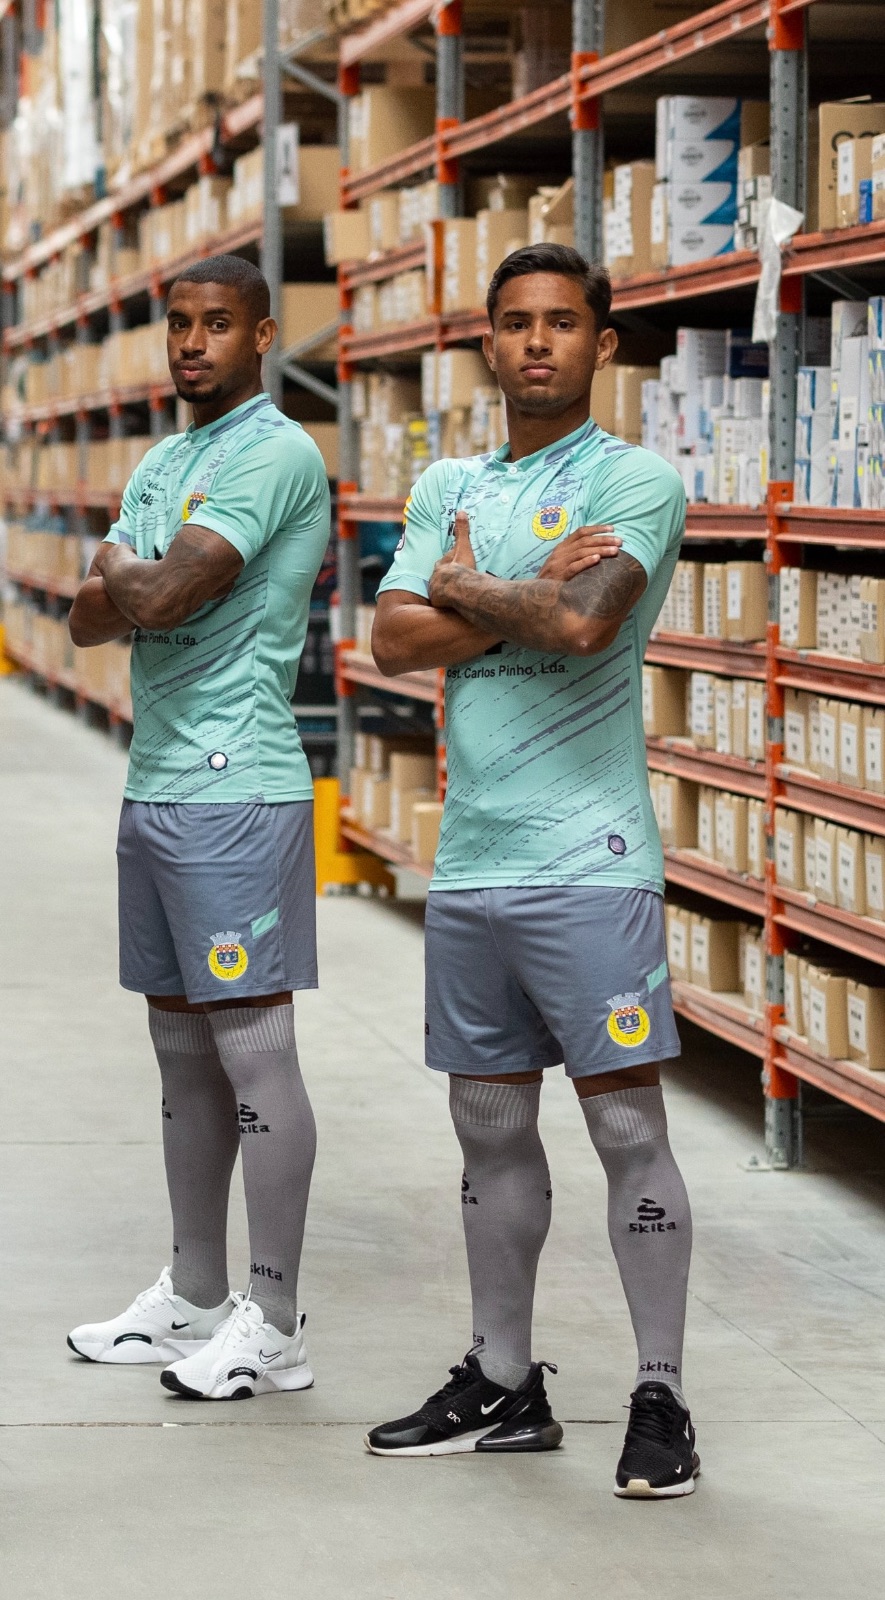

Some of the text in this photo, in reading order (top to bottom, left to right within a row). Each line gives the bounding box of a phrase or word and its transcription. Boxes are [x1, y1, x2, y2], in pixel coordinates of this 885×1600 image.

[175, 634, 199, 646] Lda.
[446, 662, 569, 679] ost. Carlos Pinho, Lda.
